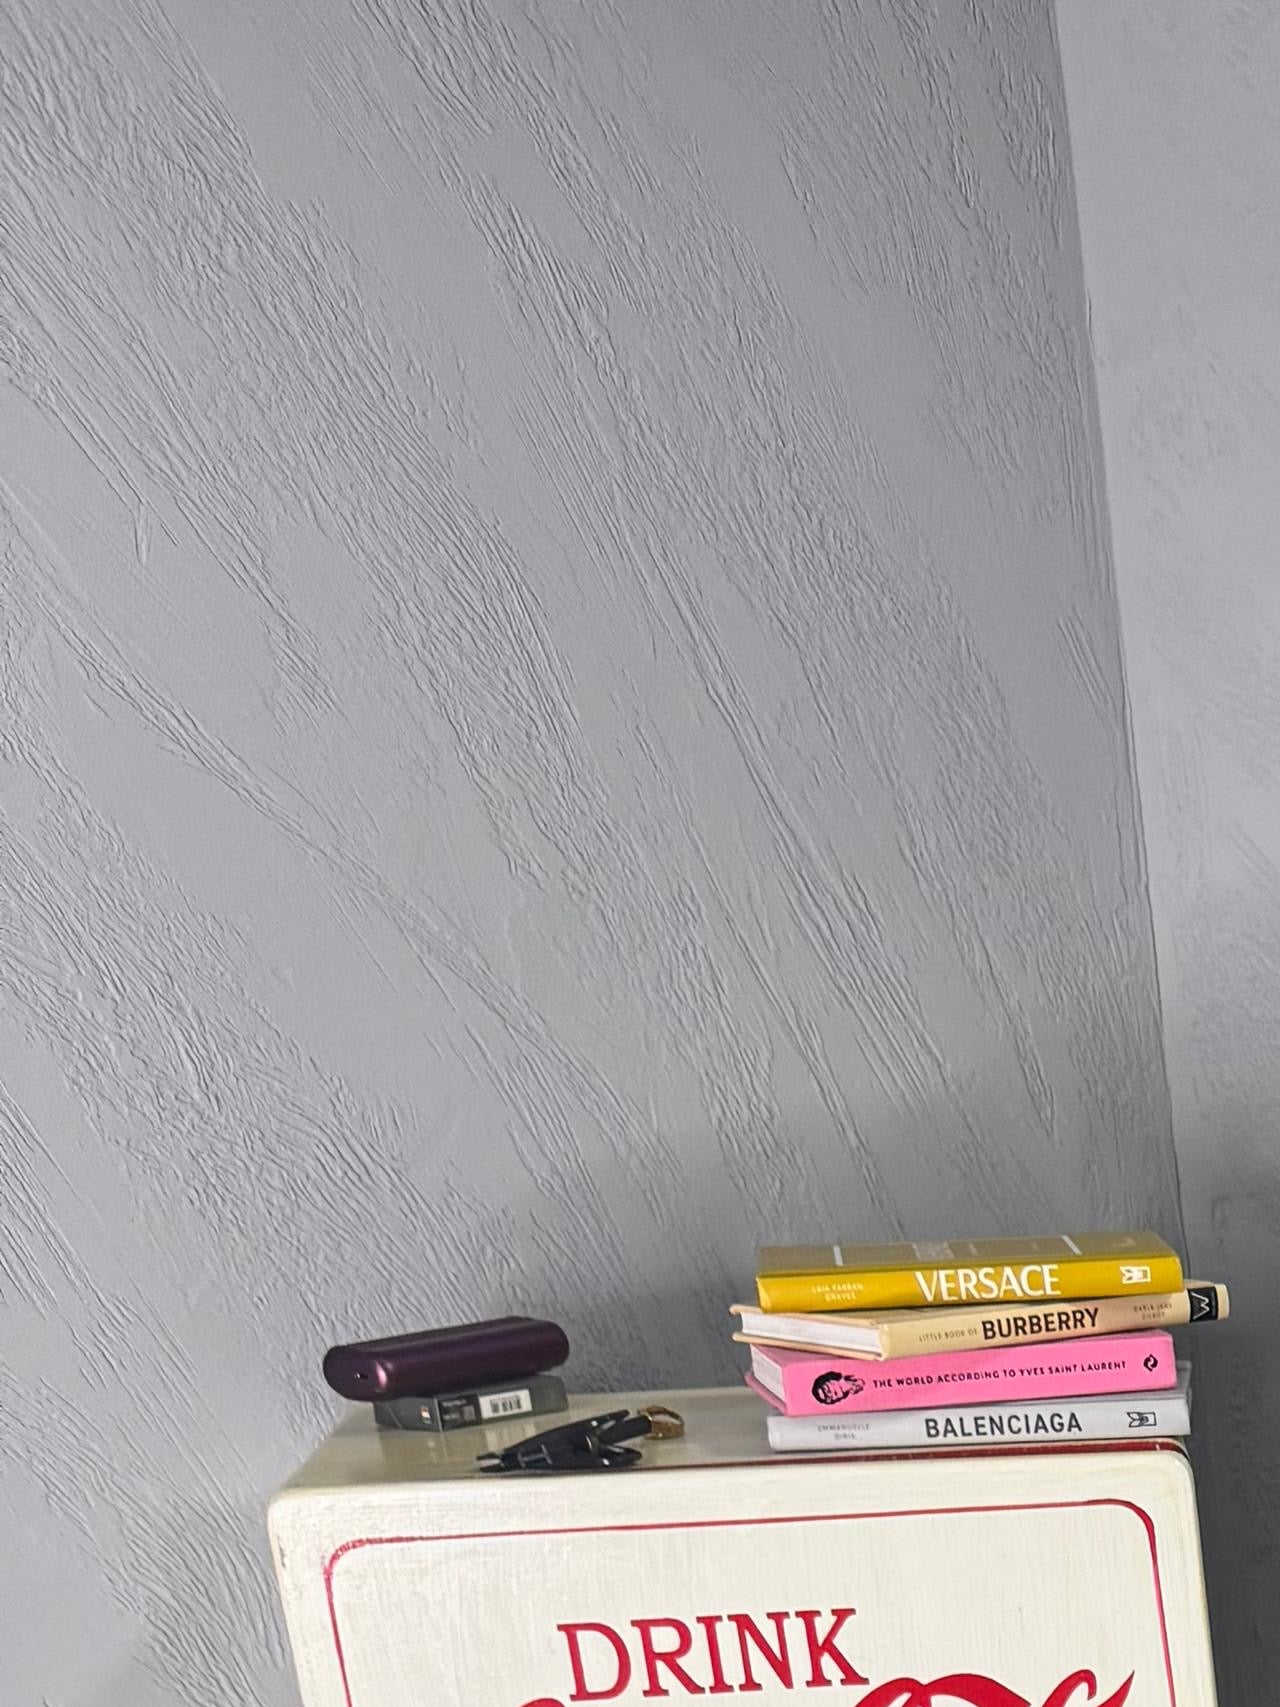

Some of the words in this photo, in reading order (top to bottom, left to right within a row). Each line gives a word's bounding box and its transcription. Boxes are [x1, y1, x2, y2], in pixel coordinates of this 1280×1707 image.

[915, 1264, 1062, 1302] VERSACE
[981, 1307, 1100, 1341] BURBERRY
[873, 1378, 893, 1389] THE
[896, 1376, 933, 1387] WORLD
[937, 1371, 1000, 1384] ACCORDING
[1003, 1368, 1016, 1379] TO
[1020, 1366, 1045, 1377] YVES
[1049, 1364, 1078, 1374] SAINT
[1081, 1361, 1127, 1372] LAURENT
[925, 1412, 1083, 1439] BALENCIAGA
[557, 1608, 868, 1700] DRINK
